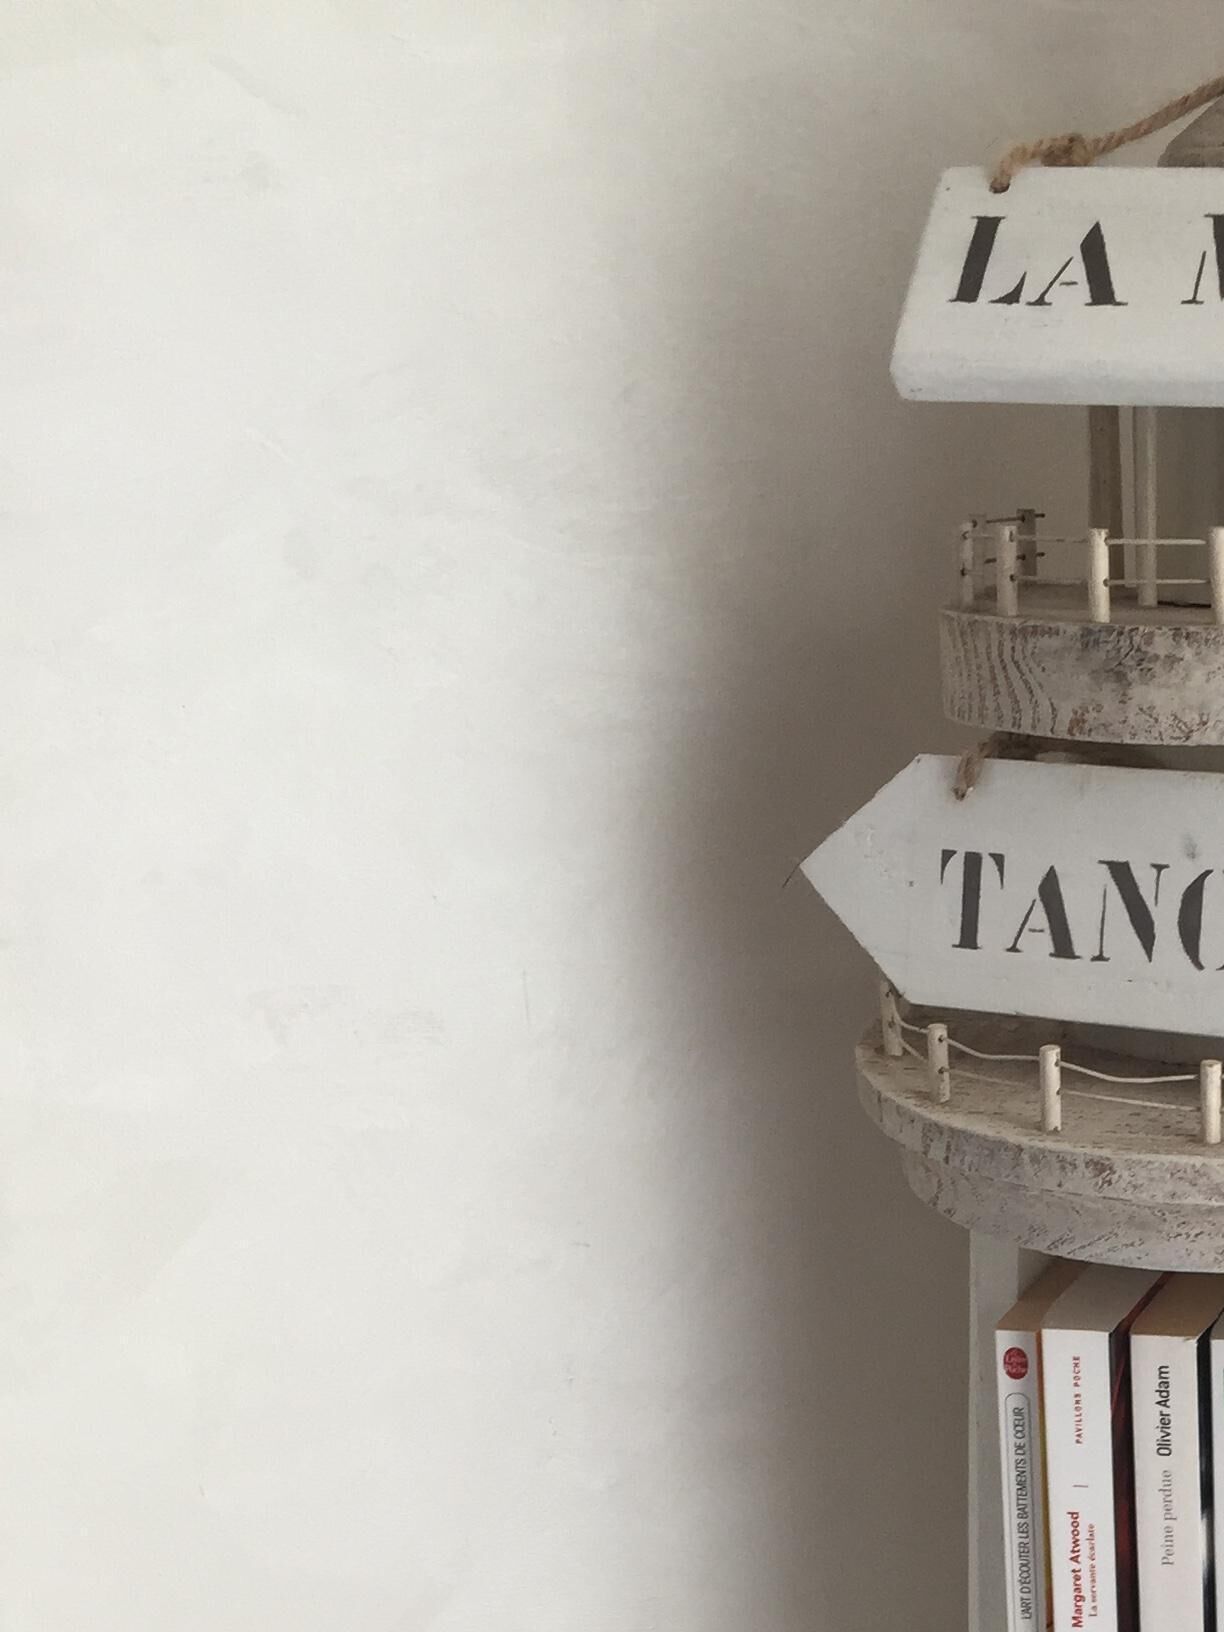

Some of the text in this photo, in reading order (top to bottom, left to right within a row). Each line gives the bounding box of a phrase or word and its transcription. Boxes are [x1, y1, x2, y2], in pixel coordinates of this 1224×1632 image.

[947, 215, 1129, 307] LA
[1072, 1355, 1083, 1445] PAVILLONS POCHE
[1154, 1365, 1173, 1457] Olivier Adam
[1014, 1442, 1027, 1456] DE
[1014, 1459, 1030, 1520] BATTEMENTS
[1157, 1469, 1178, 1566] Peine perdue
[1015, 1521, 1030, 1539] LES
[1017, 1539, 1032, 1593] D'ÉCOUTER
[1020, 1594, 1033, 1620] L'ART
[1066, 1511, 1086, 1628] Margaret Atwood
